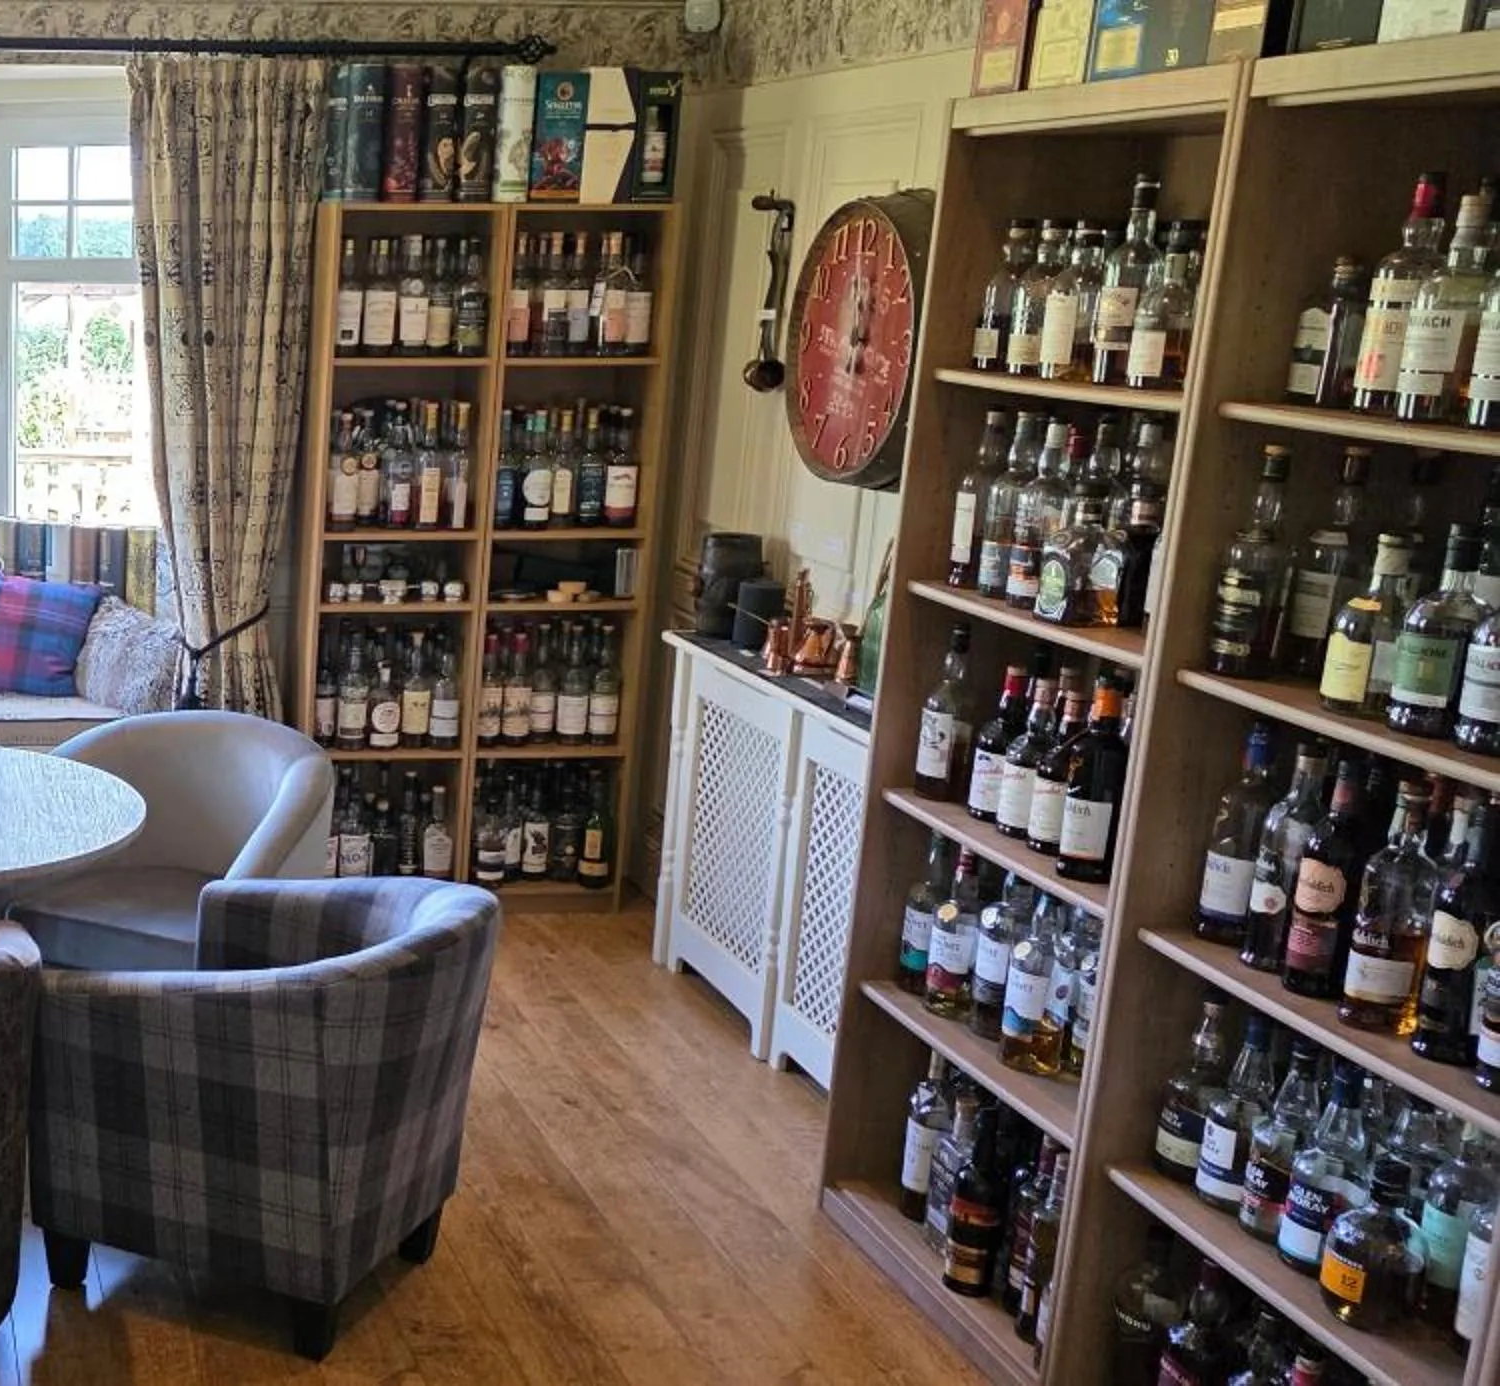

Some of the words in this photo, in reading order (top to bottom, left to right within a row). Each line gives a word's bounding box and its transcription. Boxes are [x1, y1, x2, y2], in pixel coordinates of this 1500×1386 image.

[831, 224, 849, 265] 11
[853, 217, 877, 257] 12
[885, 232, 895, 269] 1
[897, 265, 909, 304] 2
[898, 329, 911, 367] 3
[800, 376, 812, 411] 8
[811, 412, 829, 449] 7
[862, 420, 877, 457] 5
[833, 434, 850, 469] 6
